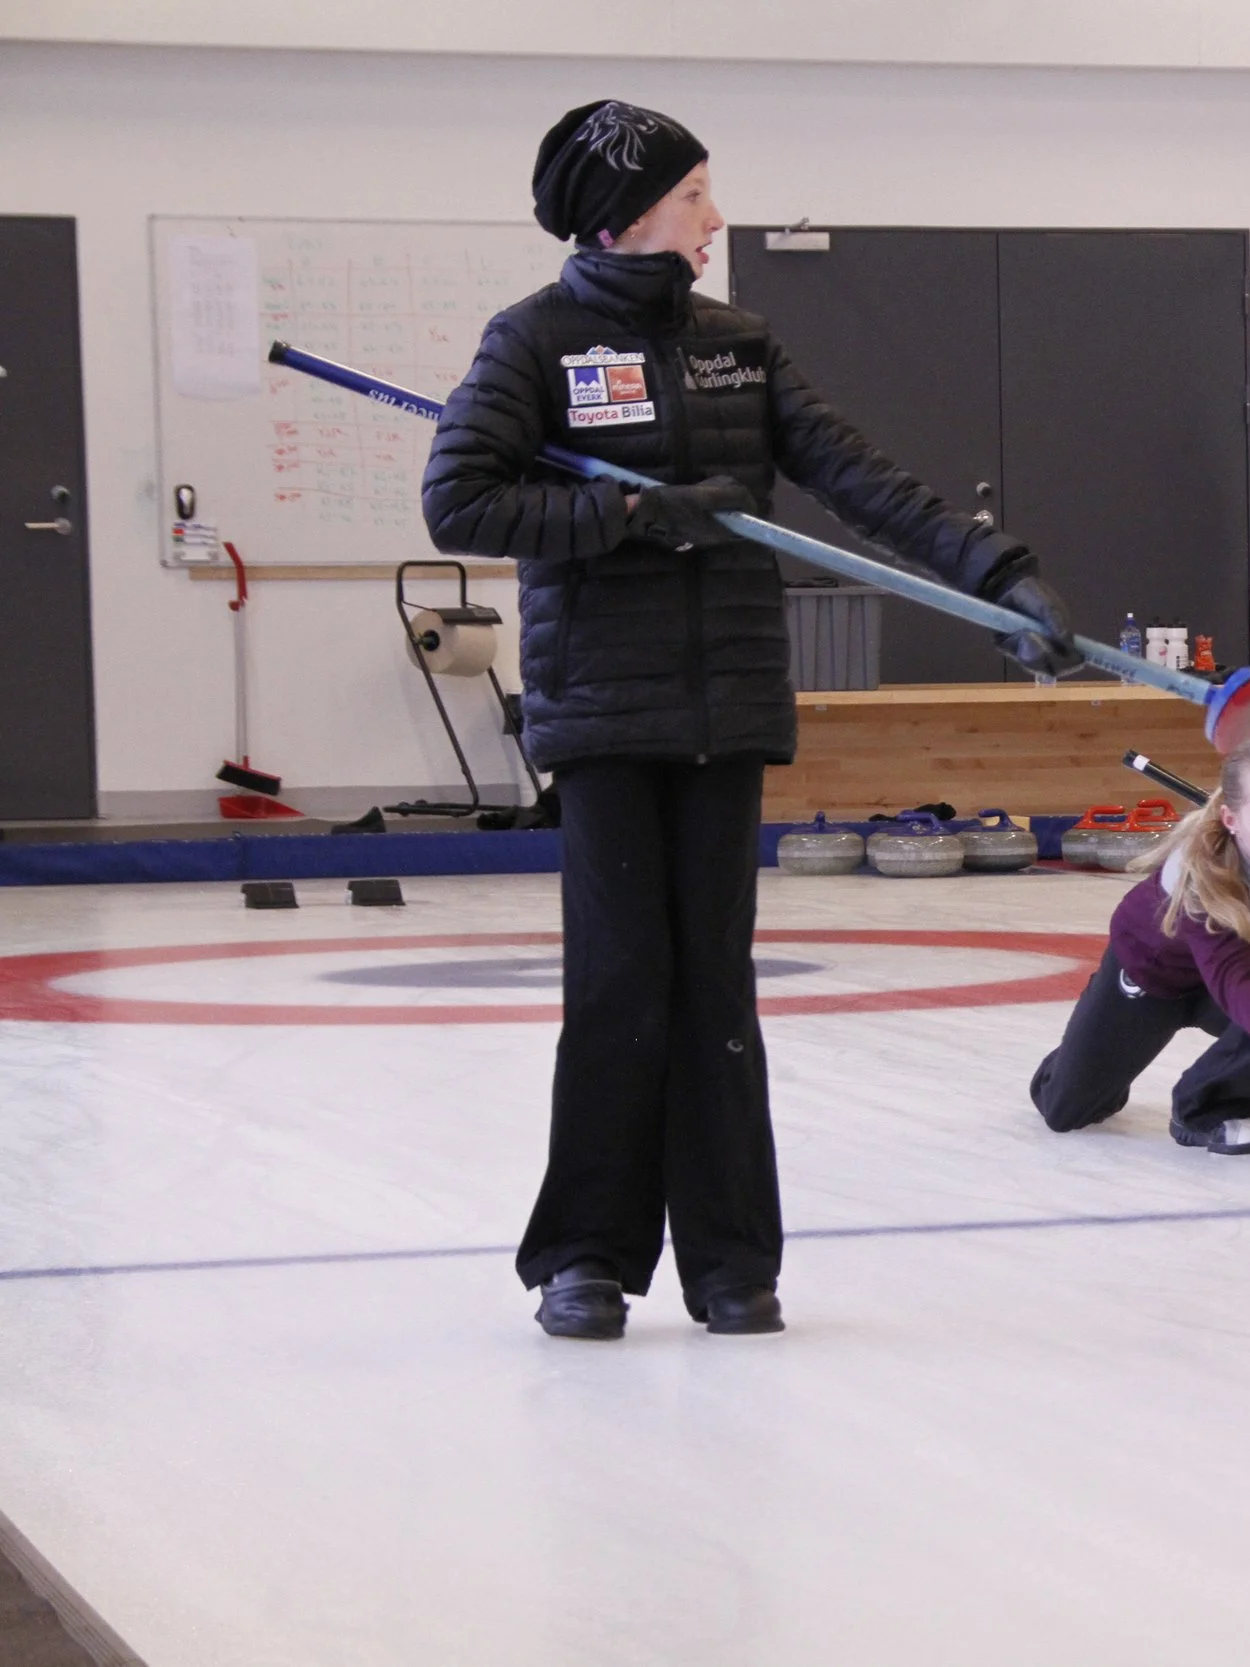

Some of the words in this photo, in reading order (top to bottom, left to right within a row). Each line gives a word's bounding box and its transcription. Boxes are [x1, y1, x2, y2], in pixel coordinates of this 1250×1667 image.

[562, 352, 645, 366] OPPDALSBANKEN
[573, 386, 604, 395] OPPDAL
[577, 394, 602, 402] EVERK
[569, 409, 619, 424] Toyota
[621, 404, 653, 418] Bilia
